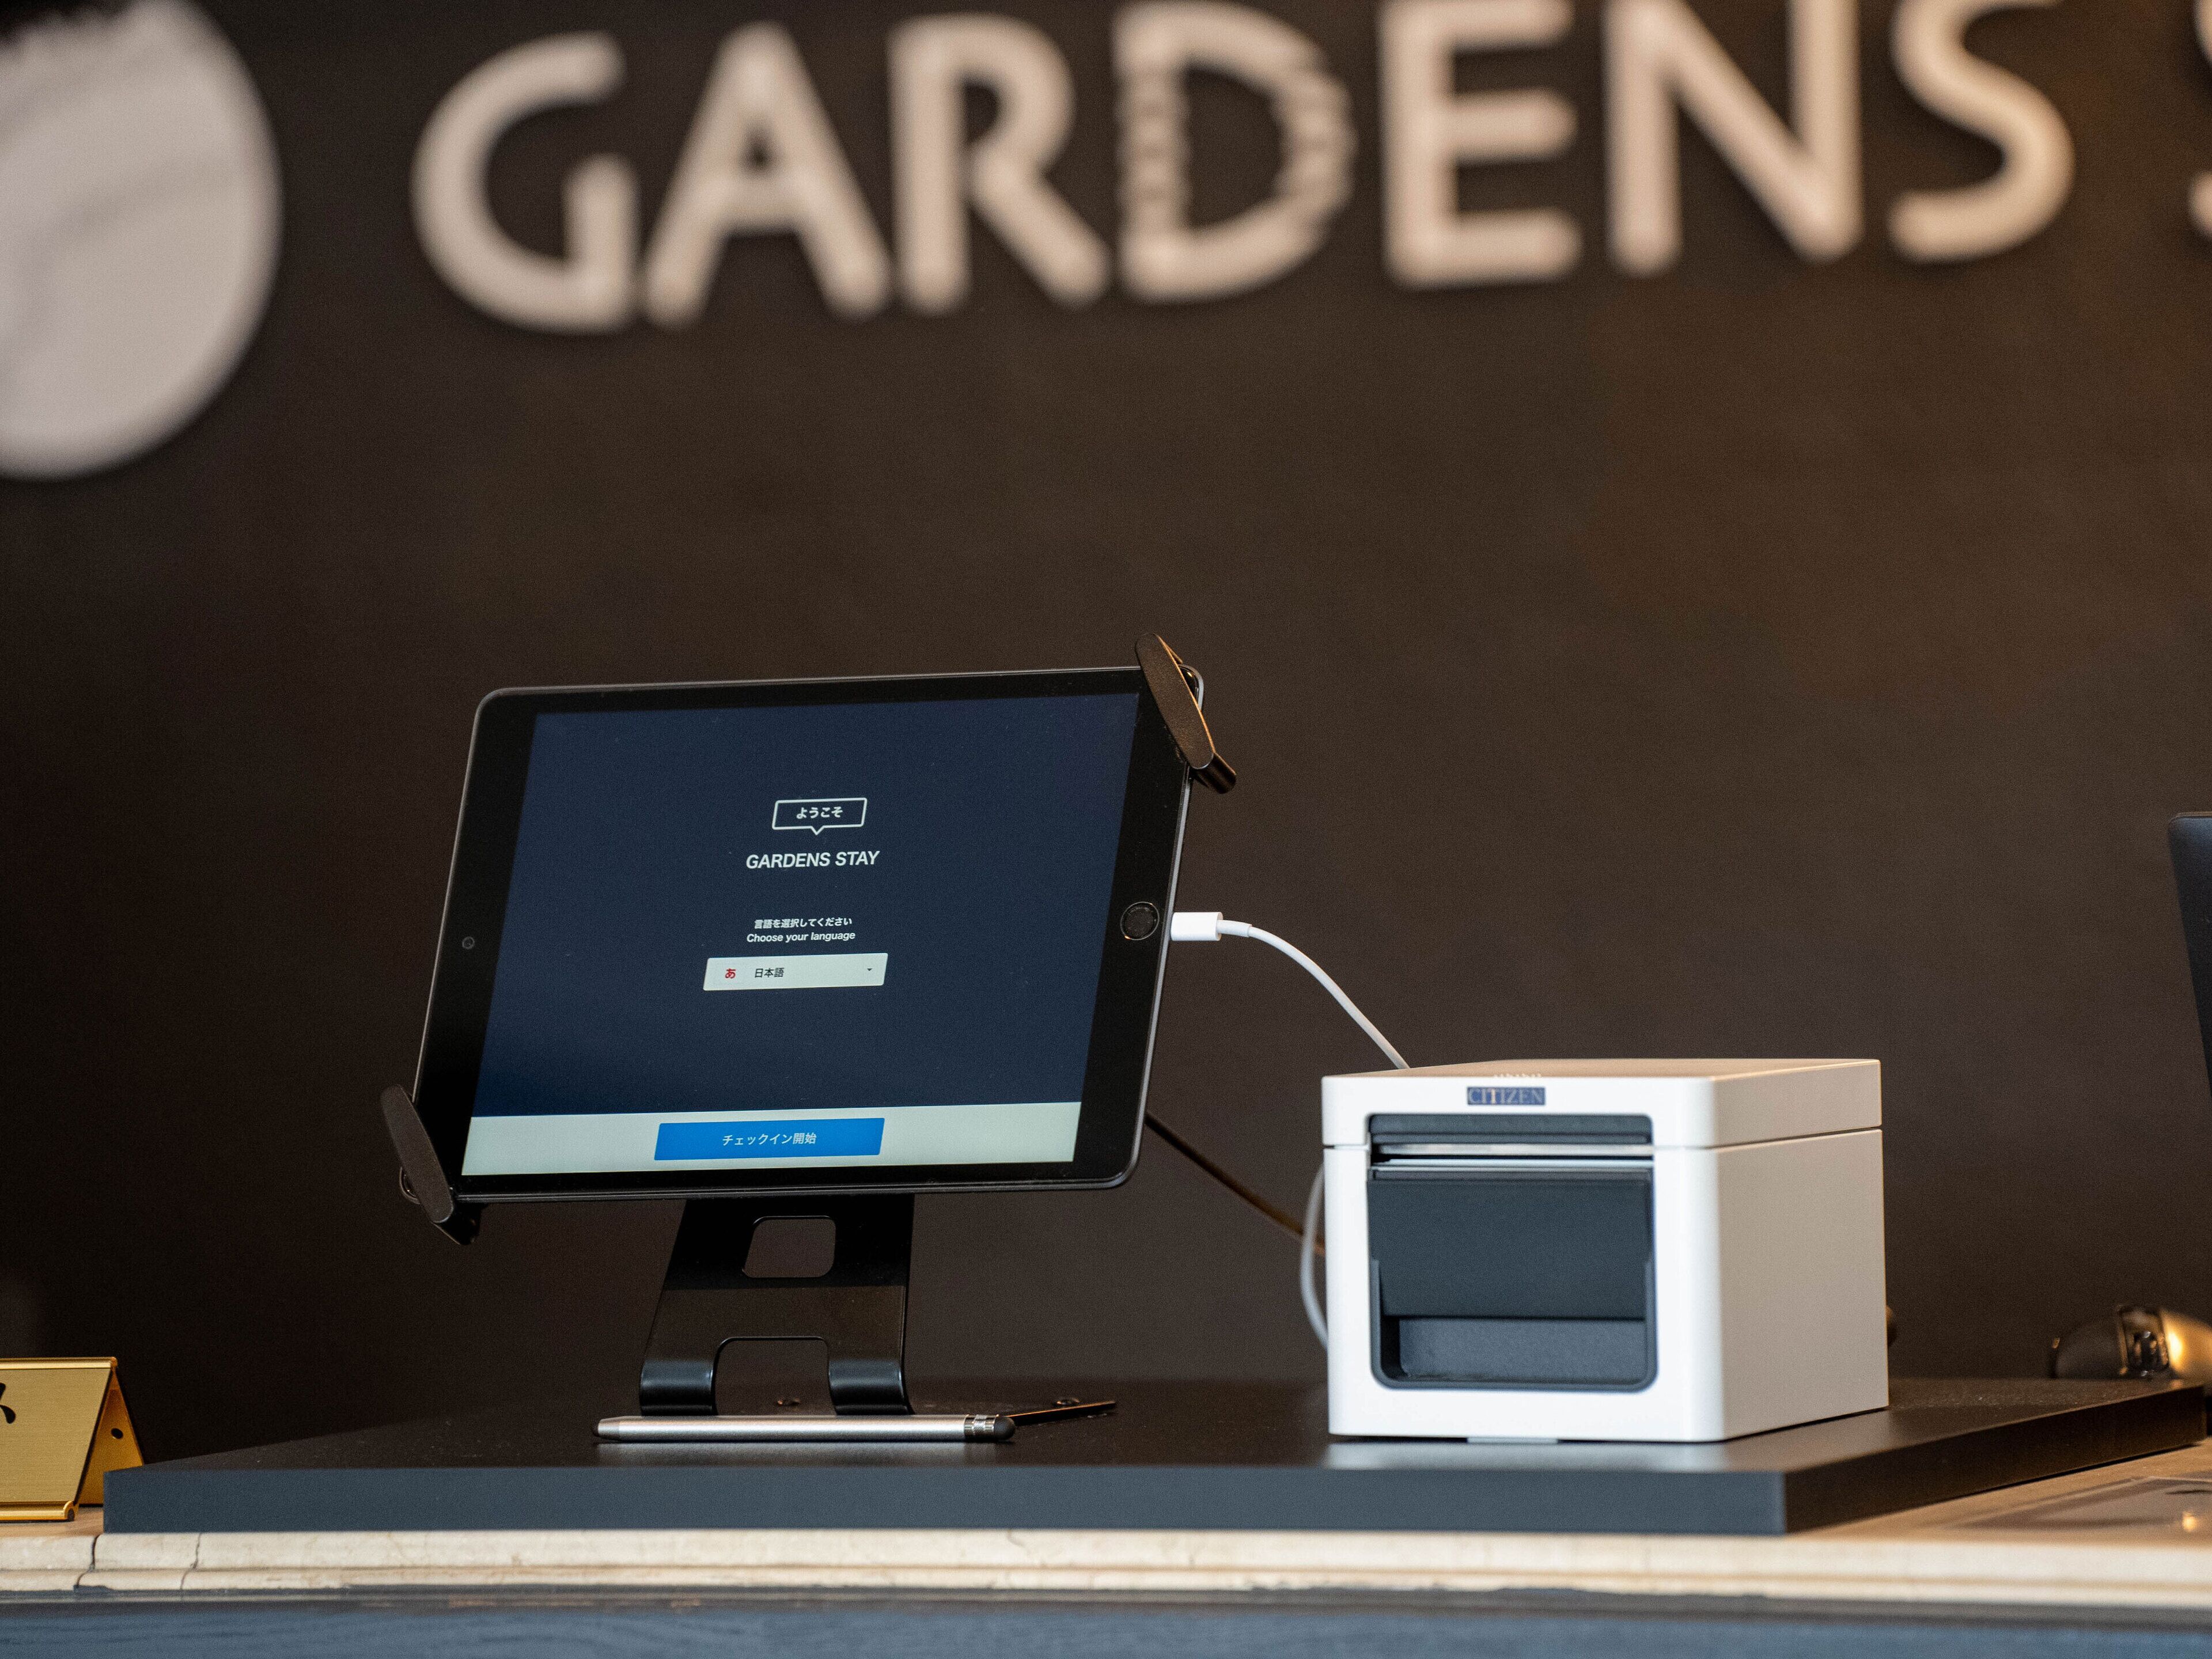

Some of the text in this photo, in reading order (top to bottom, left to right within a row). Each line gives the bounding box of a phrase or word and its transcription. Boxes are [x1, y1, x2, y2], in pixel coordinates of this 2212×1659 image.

[412, 0, 2075, 332] GARDENS
[796, 806, 843, 819] ようこそ
[746, 850, 880, 869] GARDENS STAY
[754, 918, 853, 929] 言語を選択してください
[747, 932, 855, 943] Choose your language
[725, 967, 785, 979] あ 日本語
[1468, 1088, 1544, 1104] CITIZEN
[722, 1132, 817, 1146] チェックイン開始
